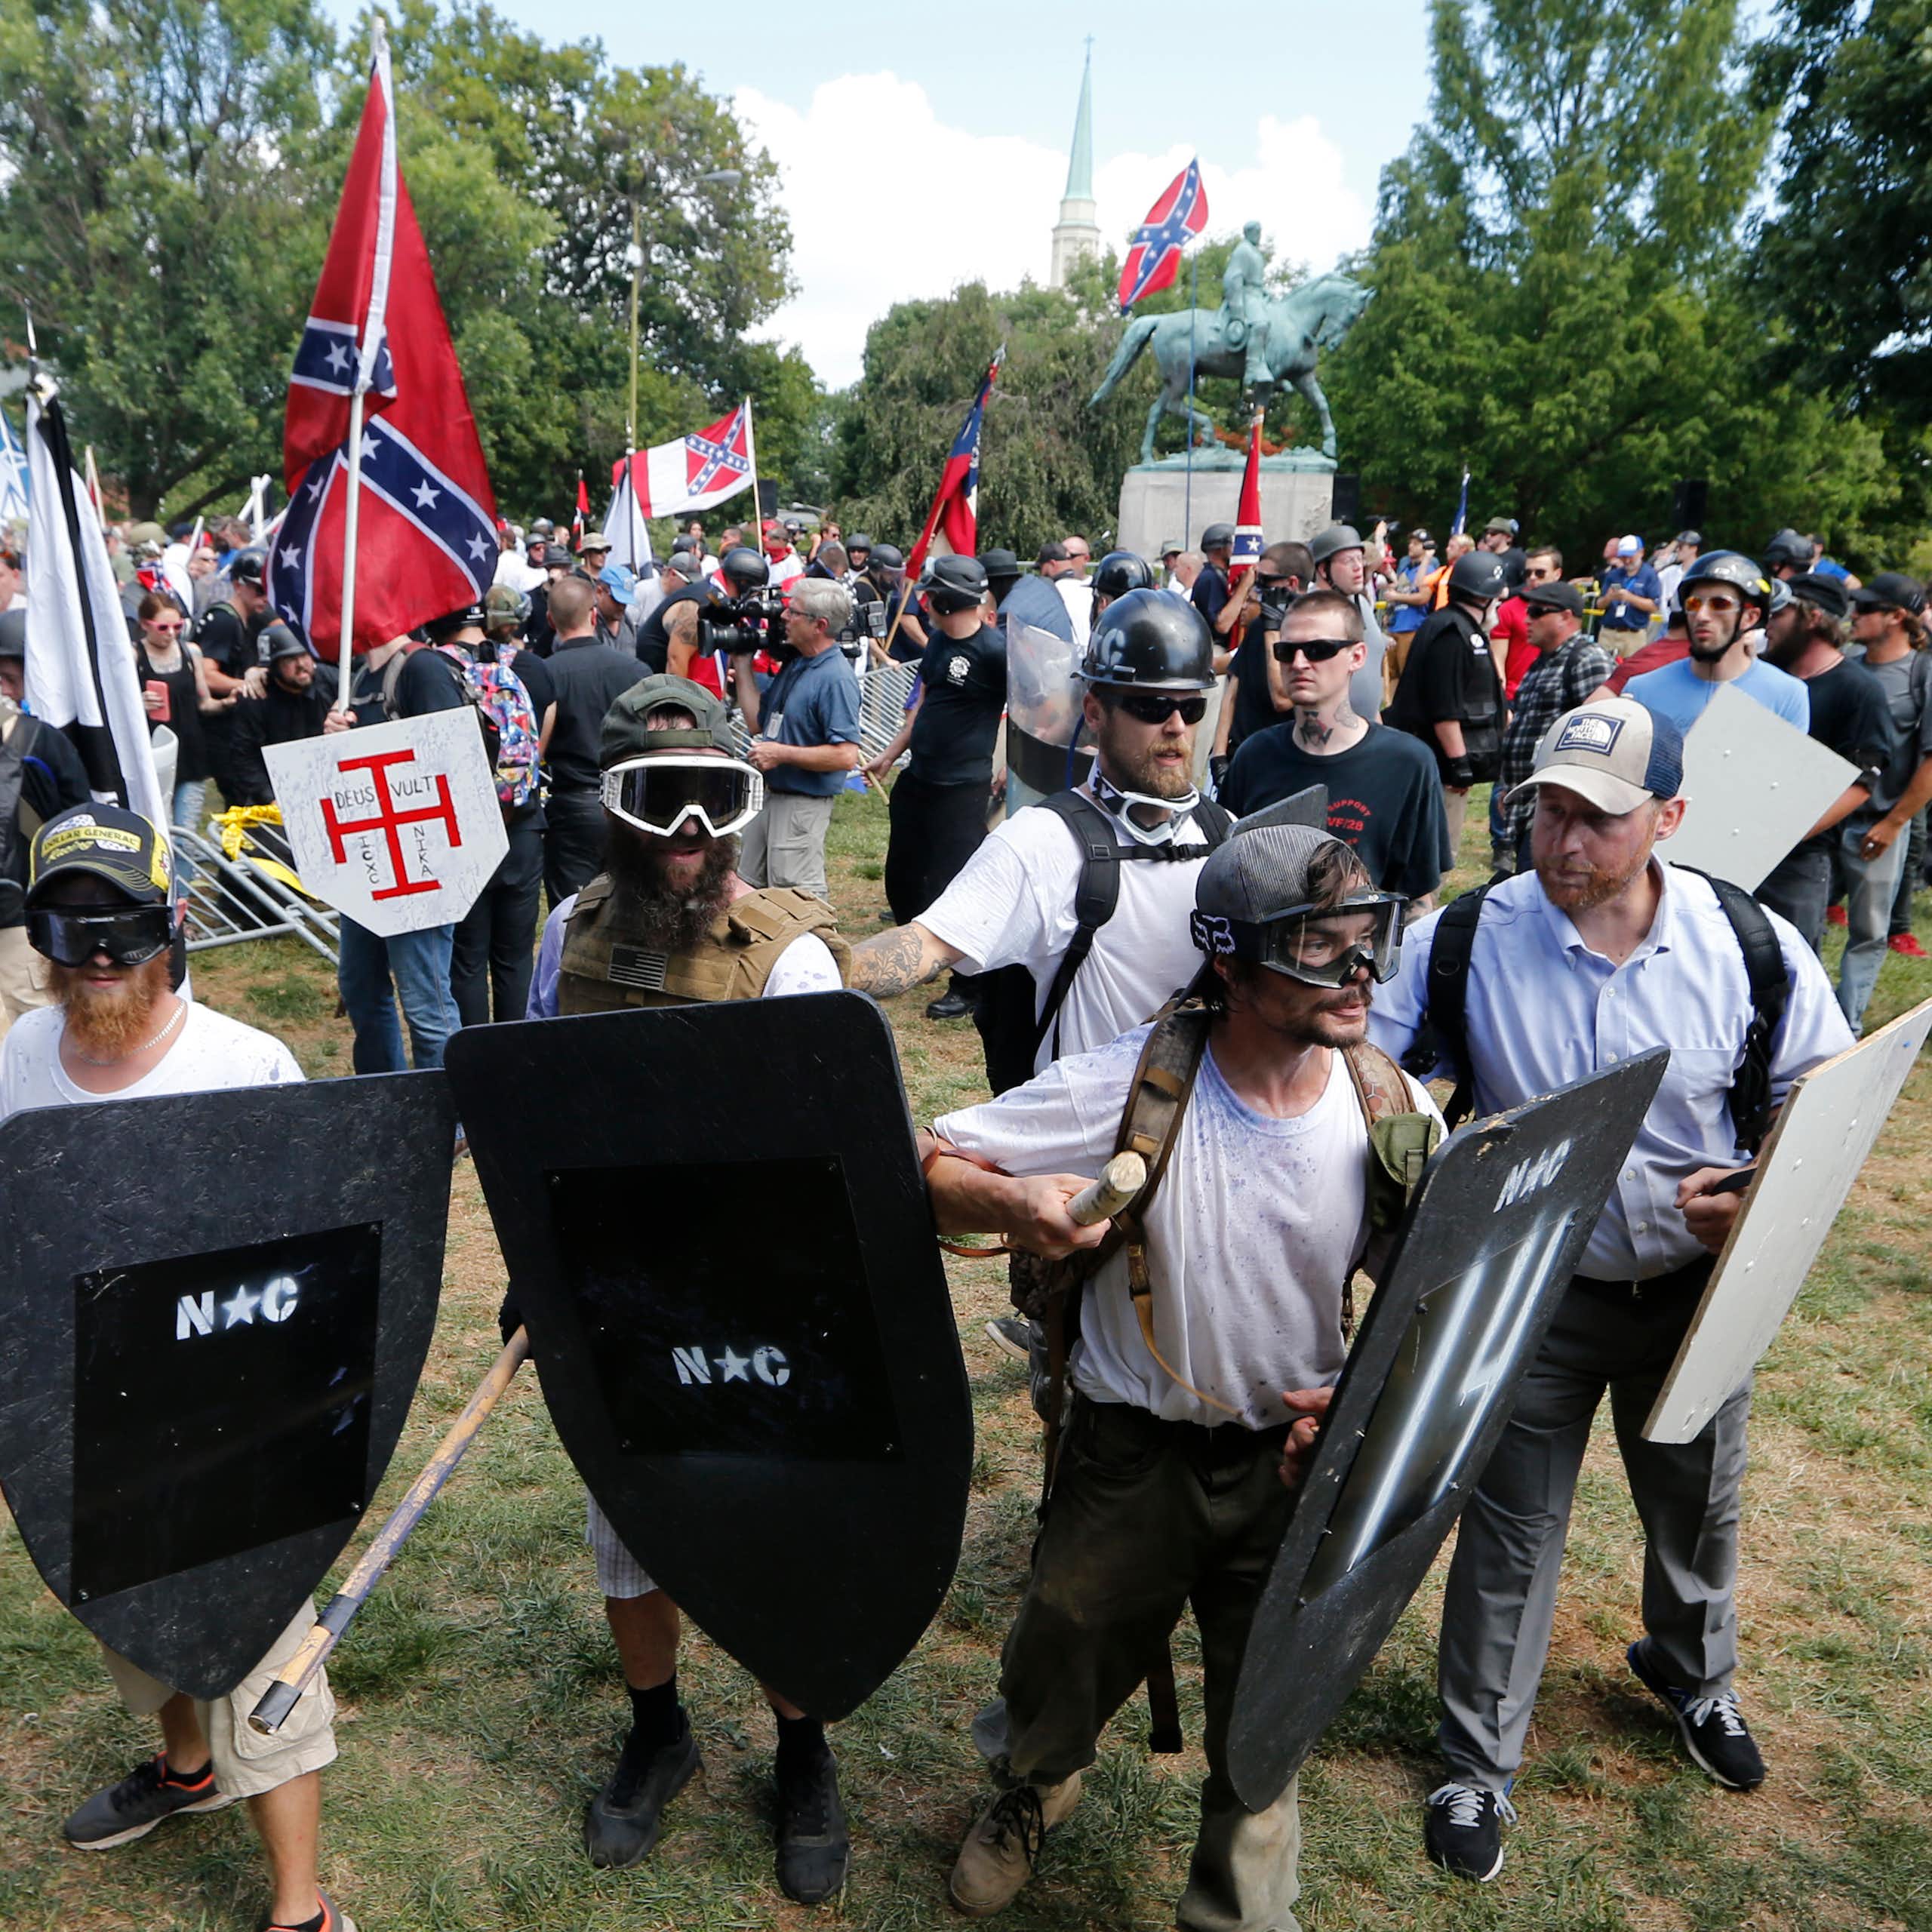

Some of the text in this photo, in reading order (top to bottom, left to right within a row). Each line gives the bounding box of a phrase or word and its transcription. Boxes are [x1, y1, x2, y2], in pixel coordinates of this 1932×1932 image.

[334, 775, 432, 809] DEUS VULT
[84, 829, 138, 846] GENERAL
[414, 825, 433, 876] NIKA
